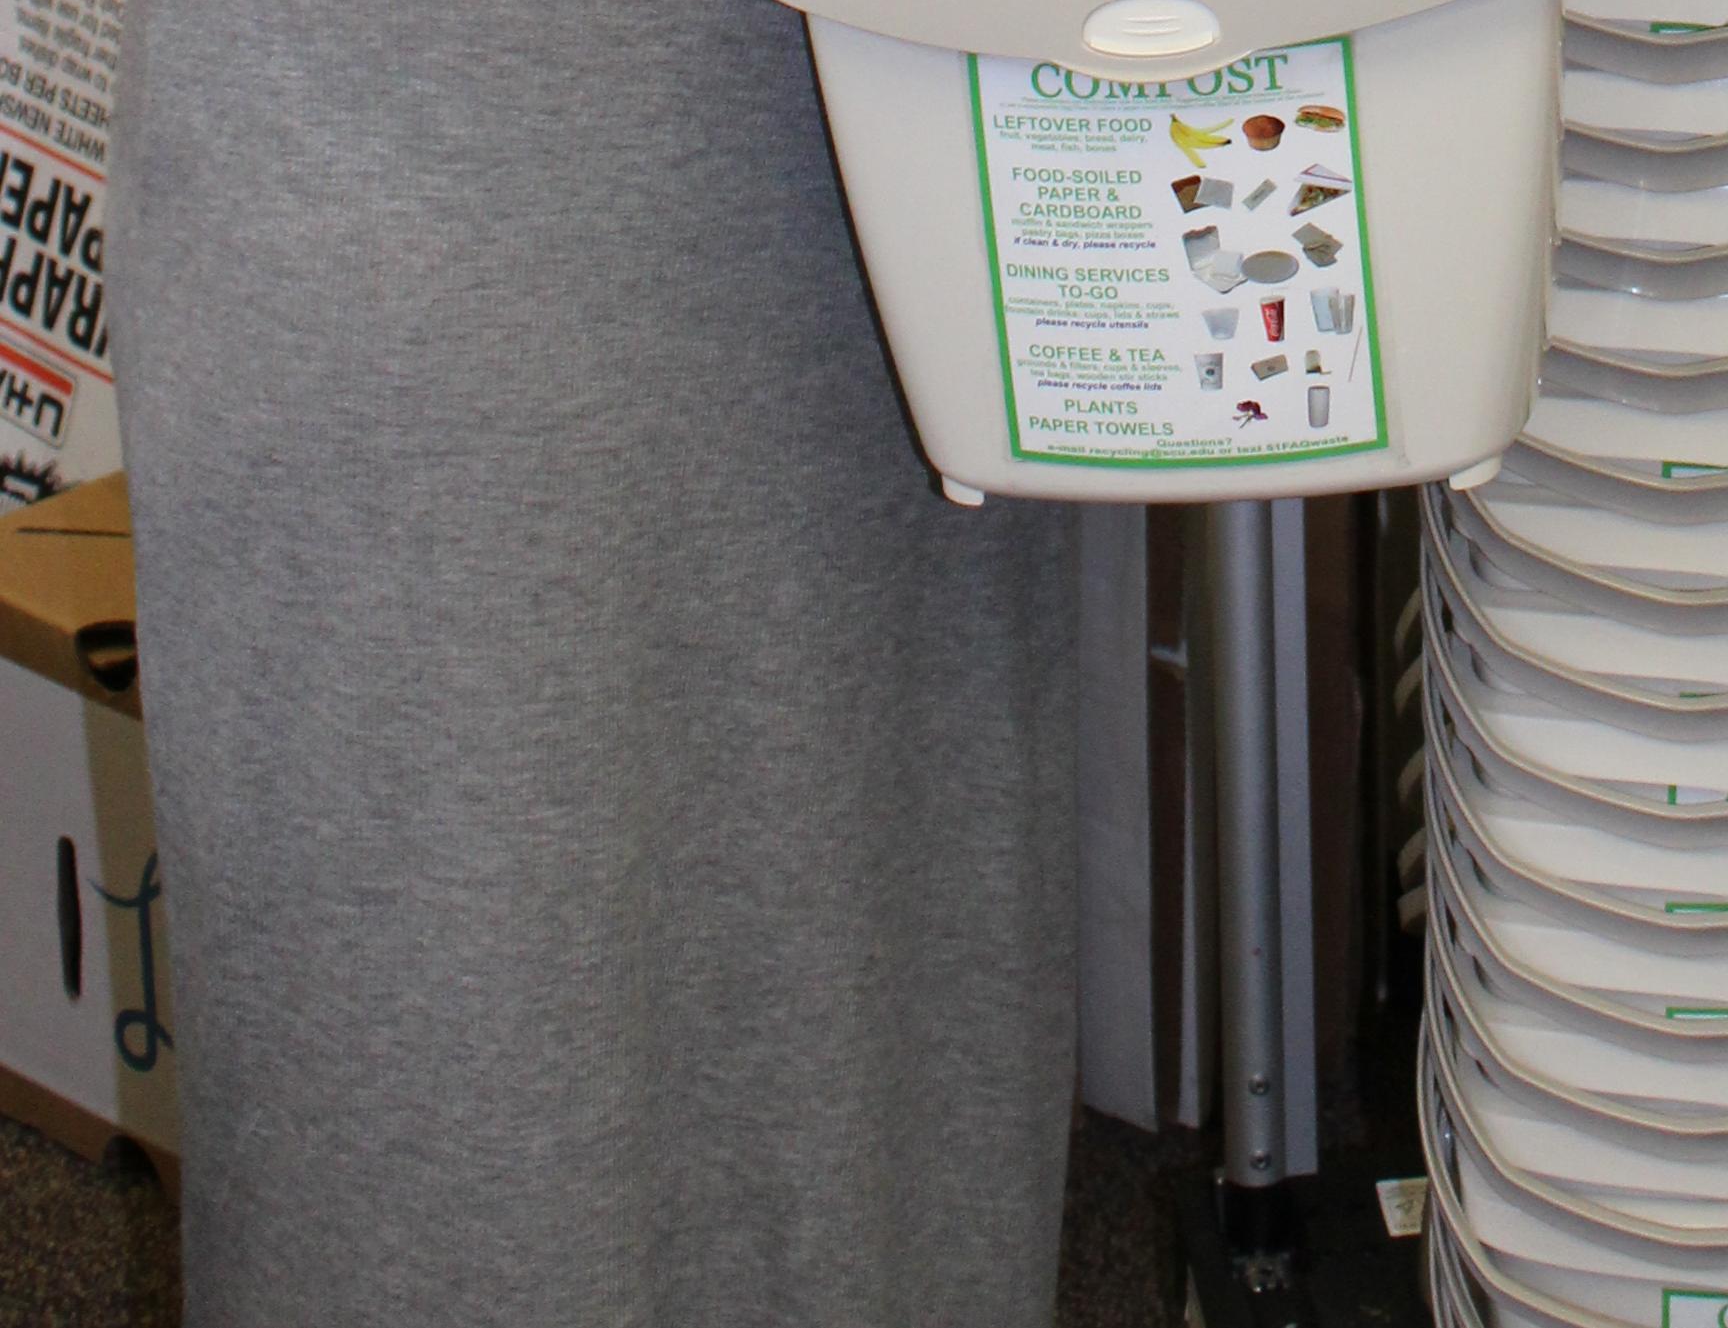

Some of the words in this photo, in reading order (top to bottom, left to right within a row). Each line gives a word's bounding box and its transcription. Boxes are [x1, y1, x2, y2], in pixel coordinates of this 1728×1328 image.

[23, 70, 57, 105] PER
[994, 115, 1090, 132] LEFTOVER
[1098, 118, 1152, 132] FOOD
[54, 118, 105, 163] WHITE
[1012, 167, 1142, 184] FOOD-SOILED
[1038, 187, 1100, 201] PAPER
[1108, 187, 1119, 202] &
[1020, 203, 1142, 219] CARDBOARD
[1023, 237, 1048, 246] clean
[1052, 239, 1059, 247] &
[1083, 240, 1116, 249] please
[1119, 240, 1156, 250] recycle
[1007, 263, 1069, 280] DINING
[1075, 268, 1170, 283] SERVICES
[0, 238, 108, 358] RAP
[1058, 285, 1118, 299] TO-GO
[1036, 317, 1067, 327] please
[1071, 320, 1106, 330] recycle
[1109, 320, 1149, 329] utensils
[1029, 344, 1102, 361] COFFEE
[1109, 349, 1121, 362] &
[1127, 348, 1165, 362] TEA
[1038, 380, 1069, 389] please
[1072, 382, 1107, 391] recycle
[1110, 383, 1141, 391] coffee
[1144, 383, 1161, 391] lids
[0, 369, 64, 437] U-H
[1065, 399, 1137, 415] PLANTS
[1029, 416, 1089, 434] PAPER
[1095, 421, 1174, 436] TOWELS
[1048, 445, 1085, 453] e-mail
[1156, 438, 1232, 448] Questions?
